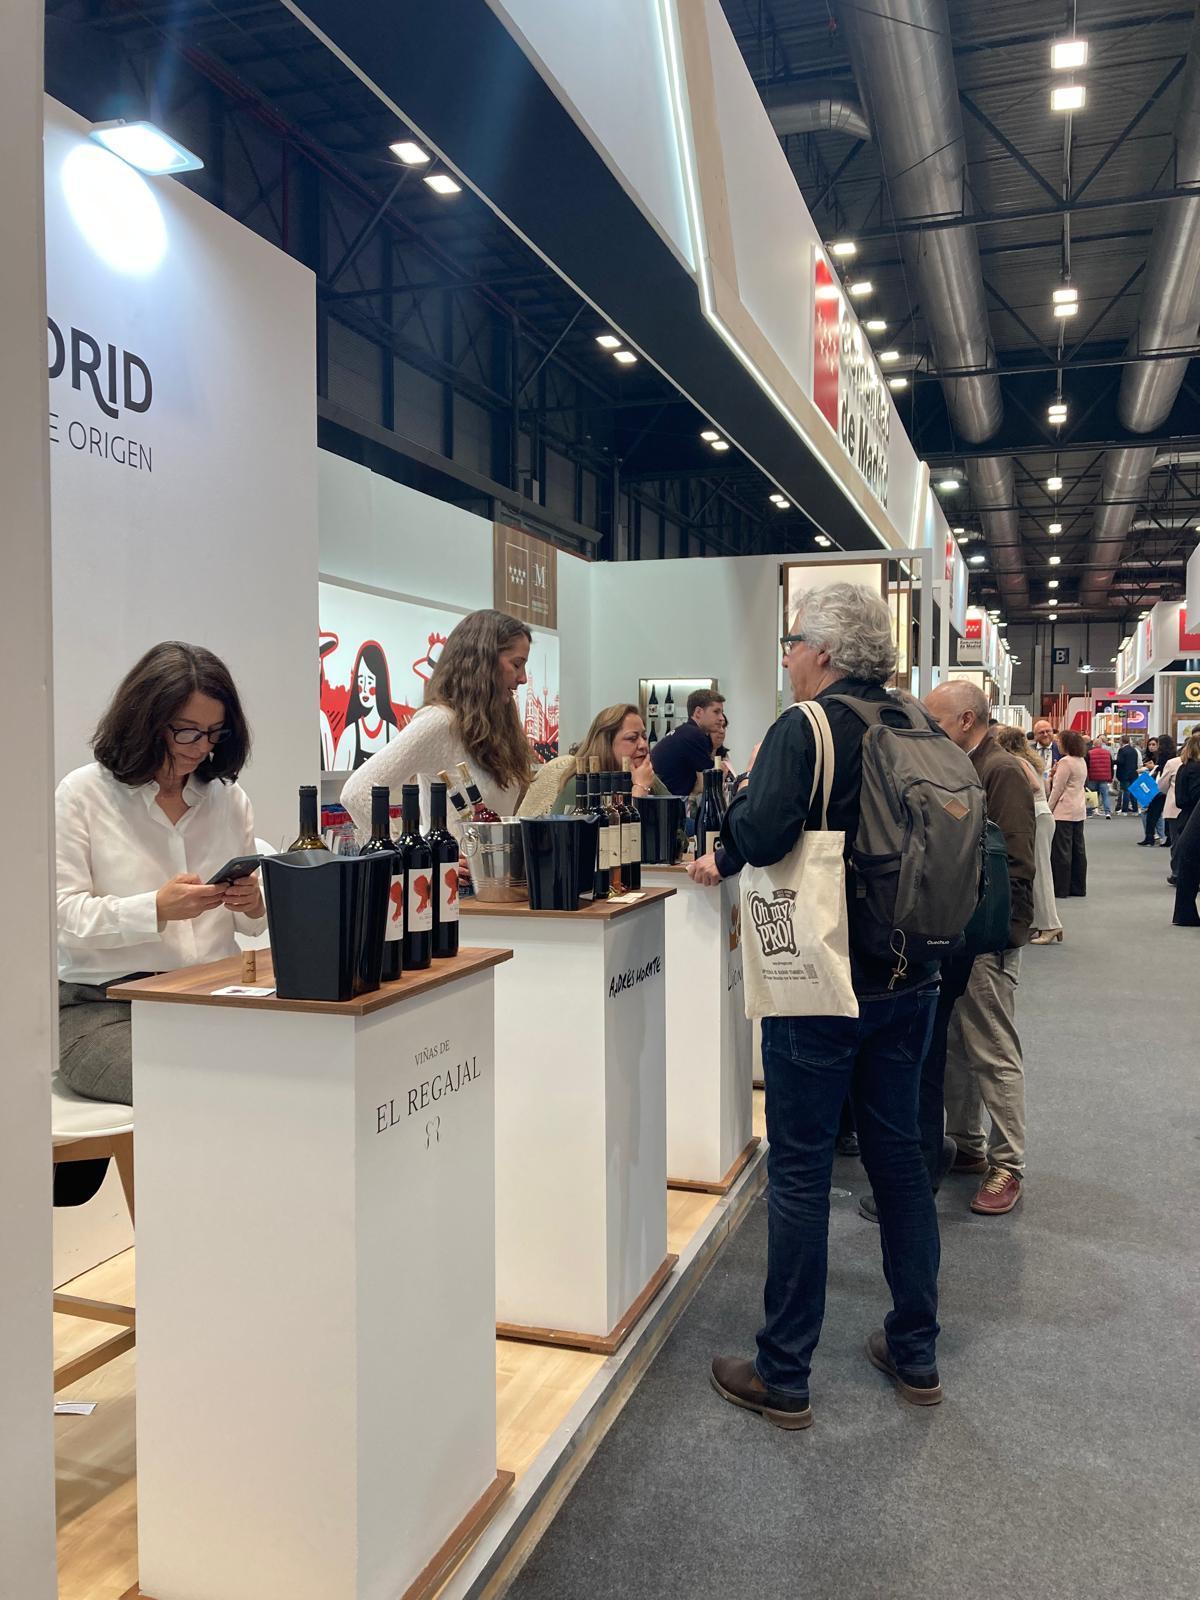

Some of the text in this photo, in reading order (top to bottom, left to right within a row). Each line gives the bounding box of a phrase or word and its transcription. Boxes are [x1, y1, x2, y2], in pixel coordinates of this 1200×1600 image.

[68, 421, 152, 472] ORIGEN
[841, 390, 888, 510] de Madrid
[1056, 650, 1065, 662] B
[753, 900, 789, 925] Oh my
[757, 919, 794, 953] PRO!
[414, 1039, 450, 1068] VIÑAS DE
[376, 1055, 481, 1134] EL REGAJAL
